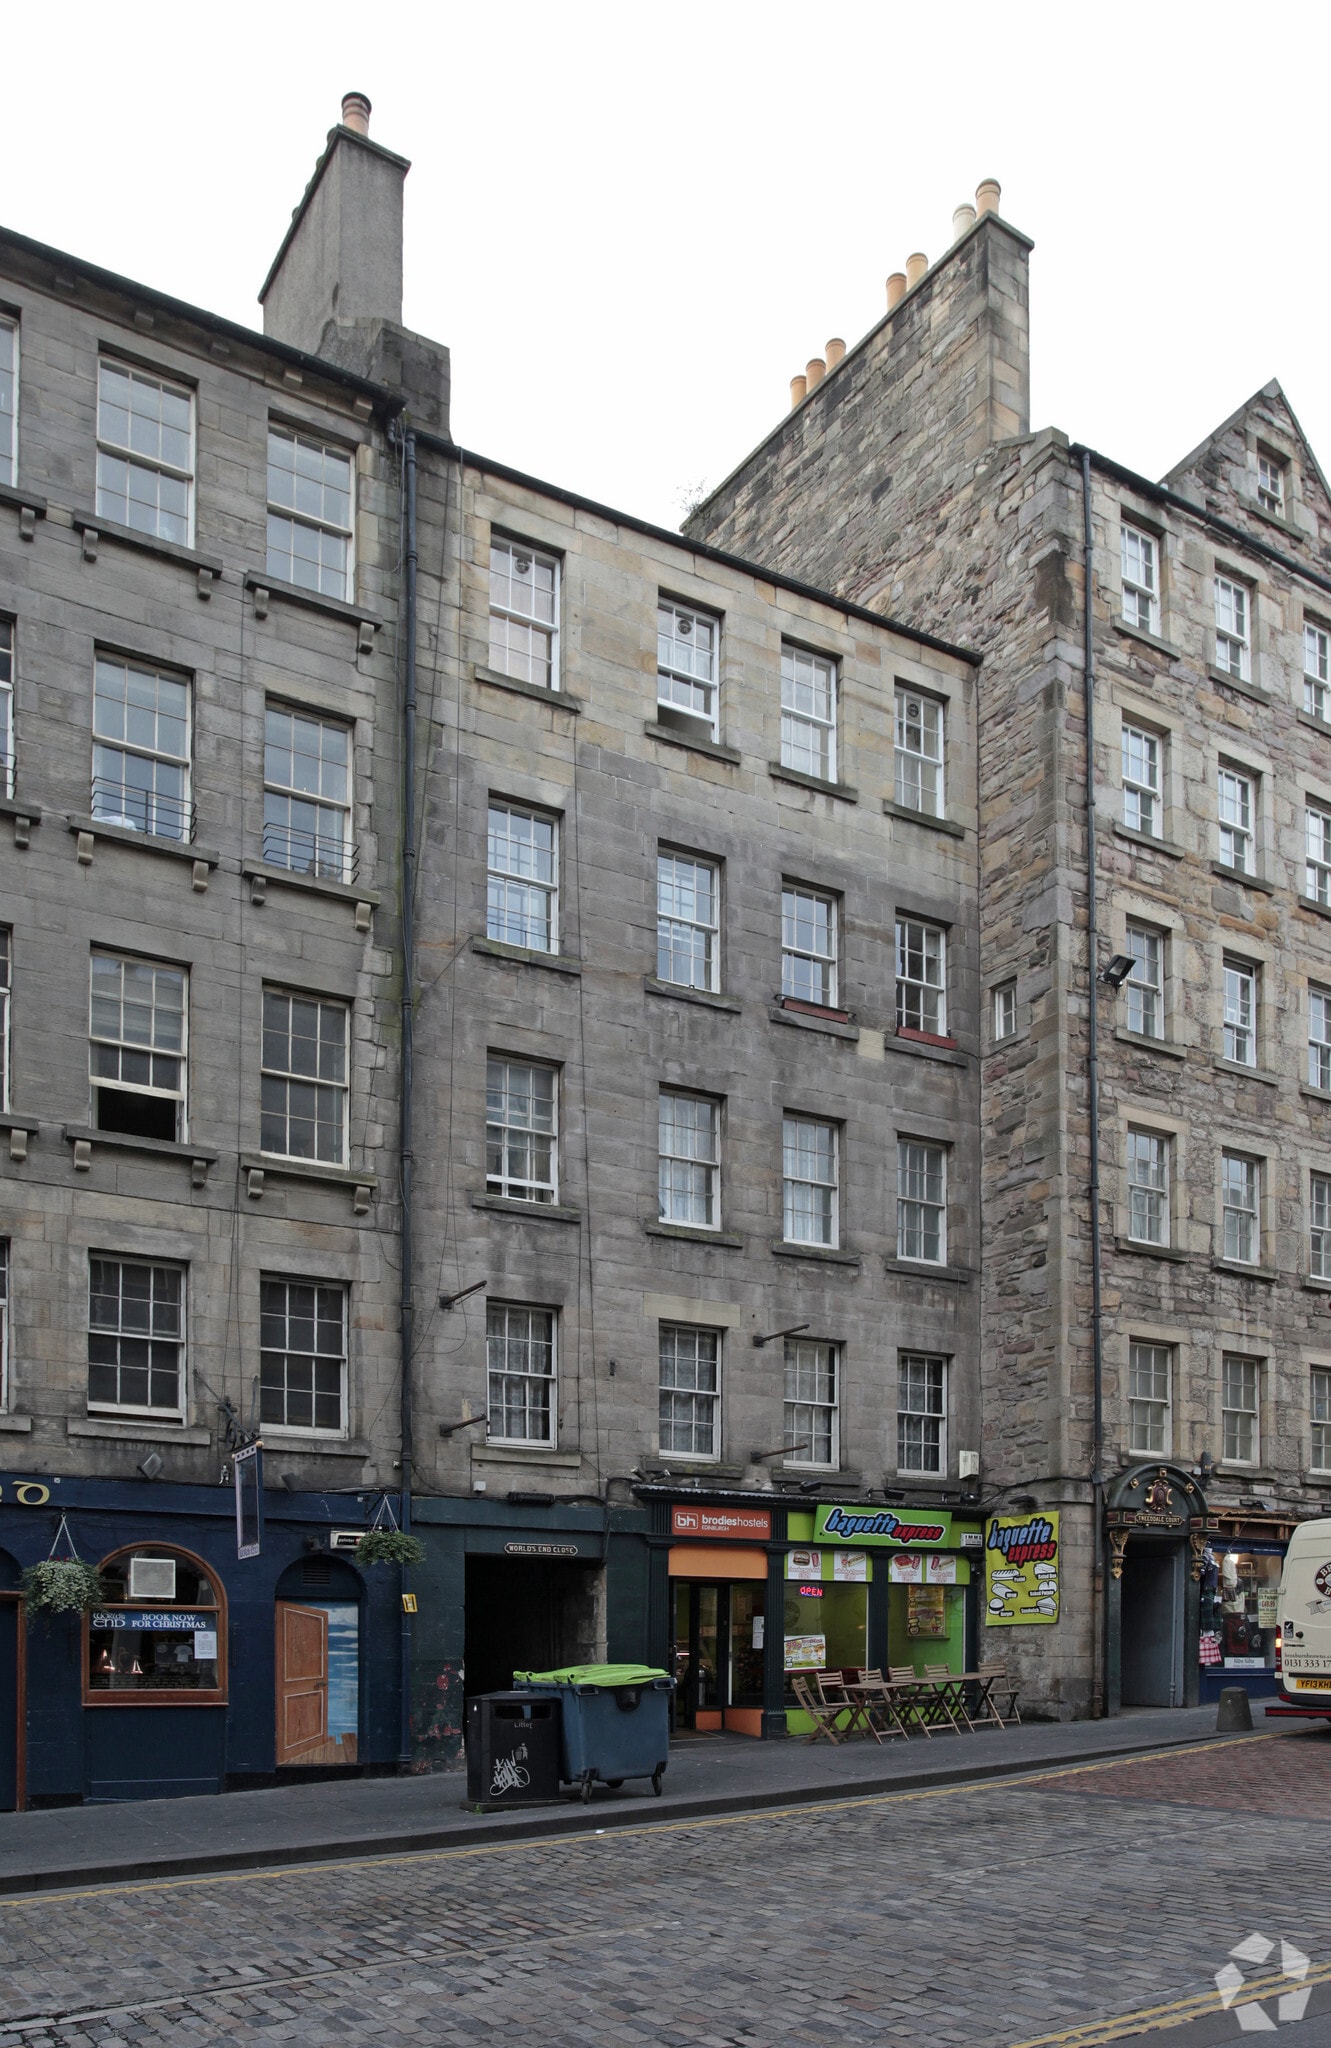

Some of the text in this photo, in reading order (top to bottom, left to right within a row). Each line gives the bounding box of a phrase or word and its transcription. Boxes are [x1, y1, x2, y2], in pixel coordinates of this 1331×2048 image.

[677, 1514, 696, 1527] bh
[826, 1509, 943, 1543] baguette express
[988, 1520, 1051, 1554] baguette
[552, 1546, 574, 1554] CLOSE
[1008, 1542, 1056, 1567] express
[800, 1587, 823, 1597] OPEN
[142, 1613, 170, 1621] BOOK
[131, 1620, 206, 1628] FOR CHRISTMAS
[1284, 1659, 1301, 1668] 0131
[1304, 1660, 1320, 1668] 333
